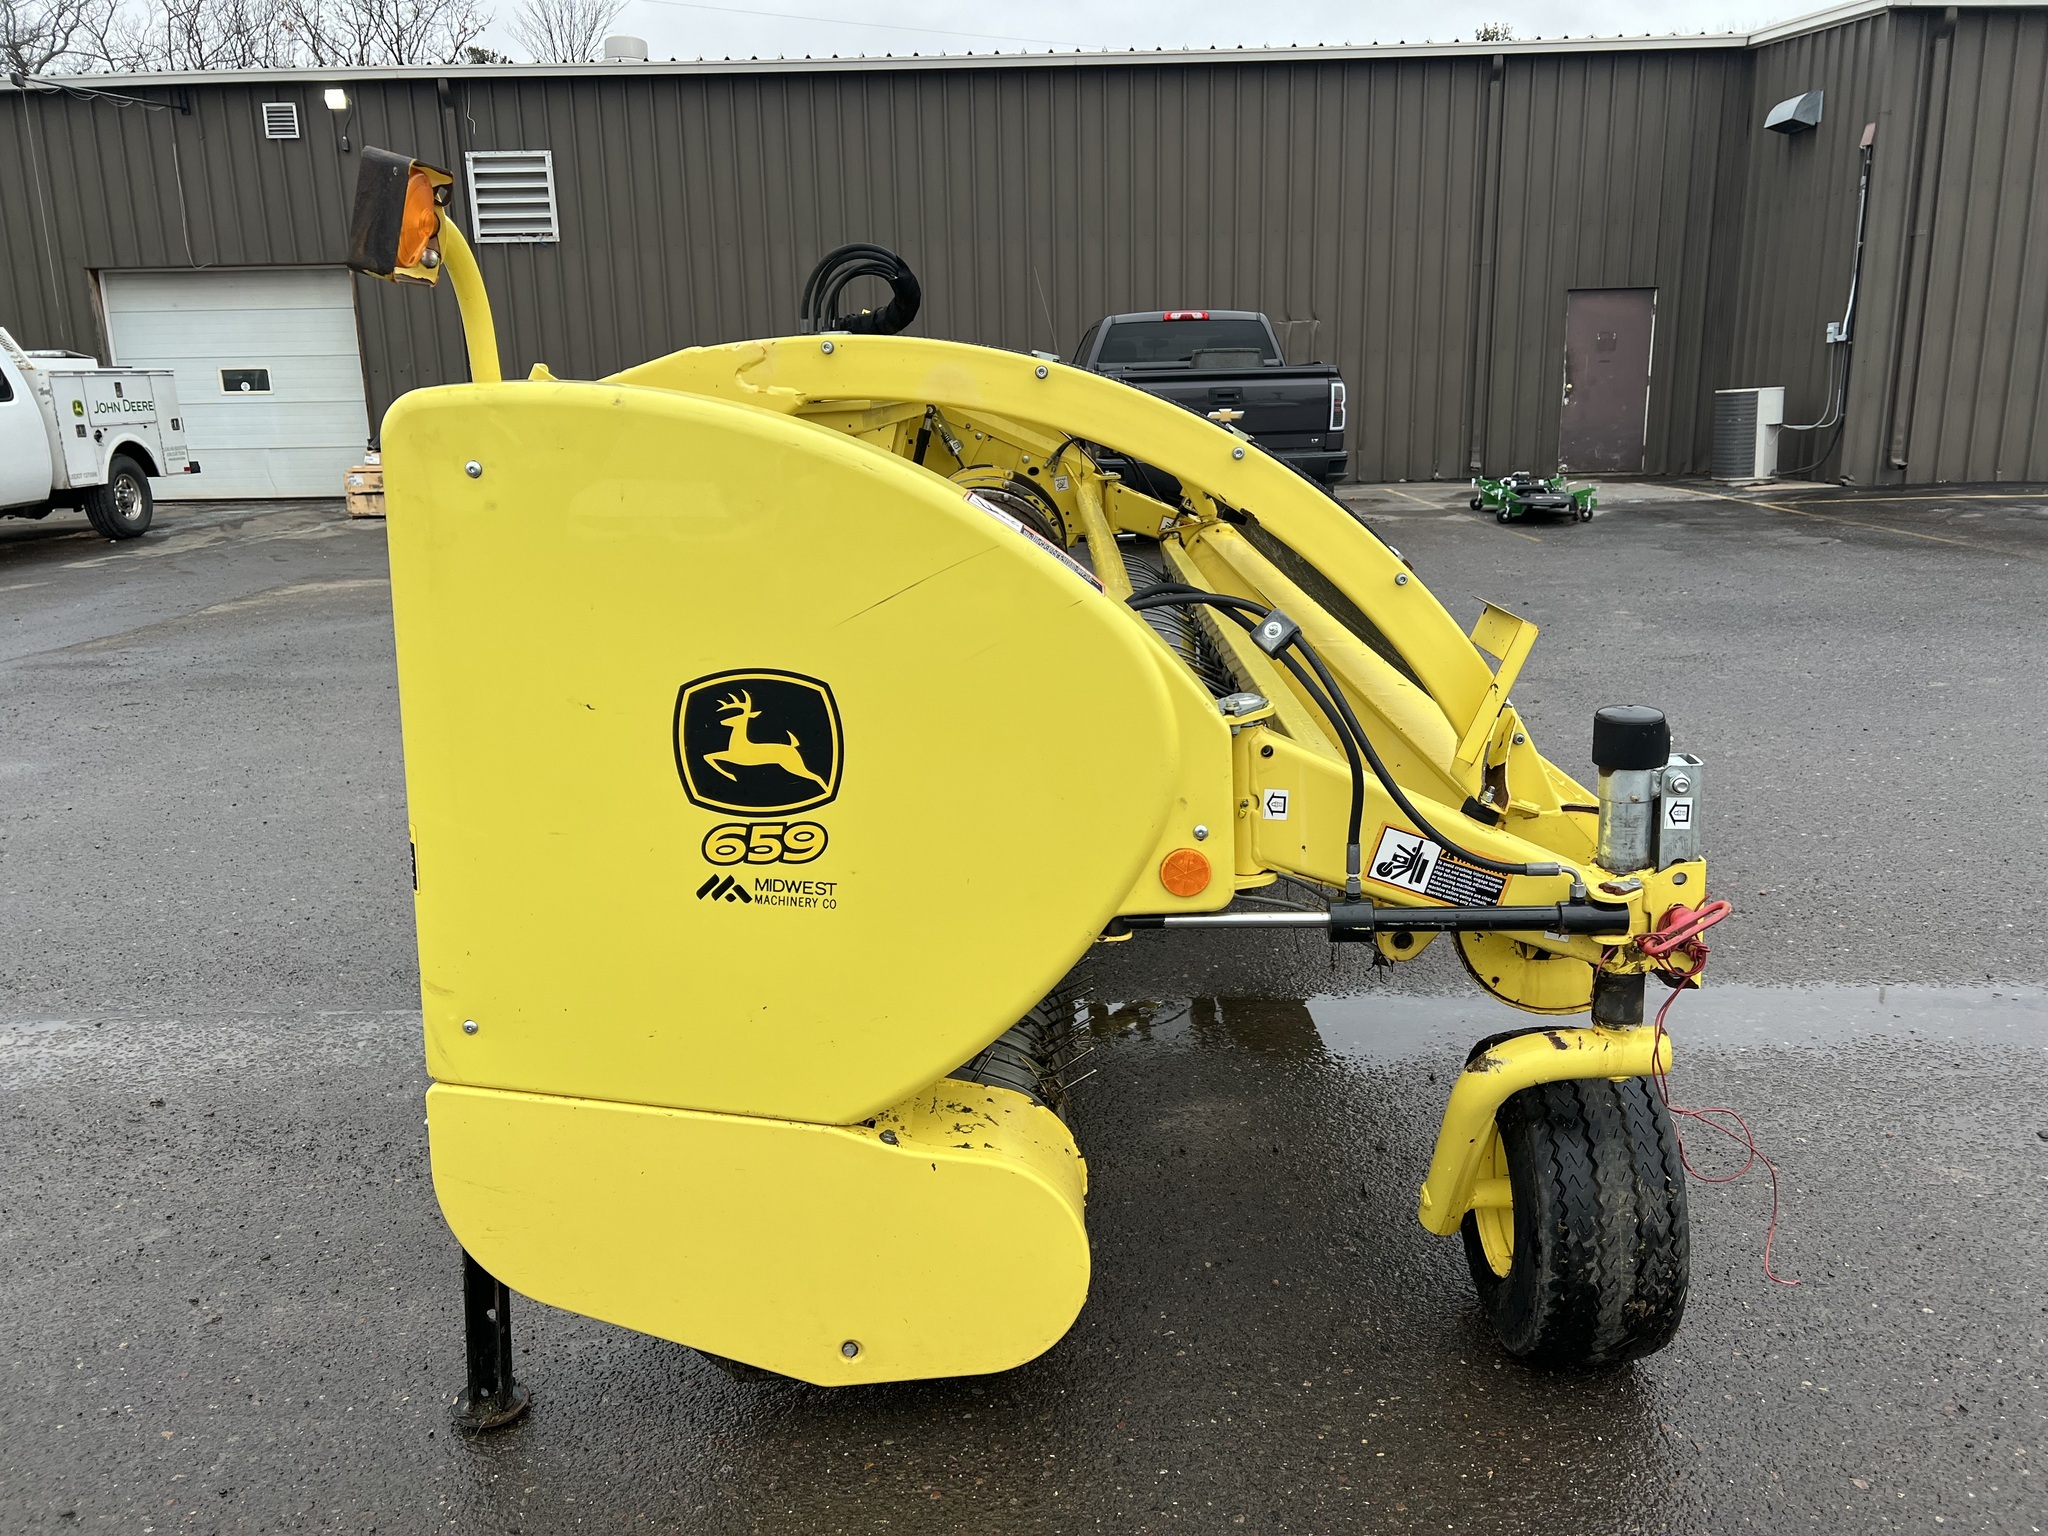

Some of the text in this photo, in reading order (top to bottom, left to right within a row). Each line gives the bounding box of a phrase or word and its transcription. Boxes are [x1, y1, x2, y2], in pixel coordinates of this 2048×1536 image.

[94, 399, 154, 413] JOHN DEERE
[701, 821, 828, 866] 659
[754, 877, 837, 896] MIDWEST
[754, 894, 837, 910] MACHINERY CO
